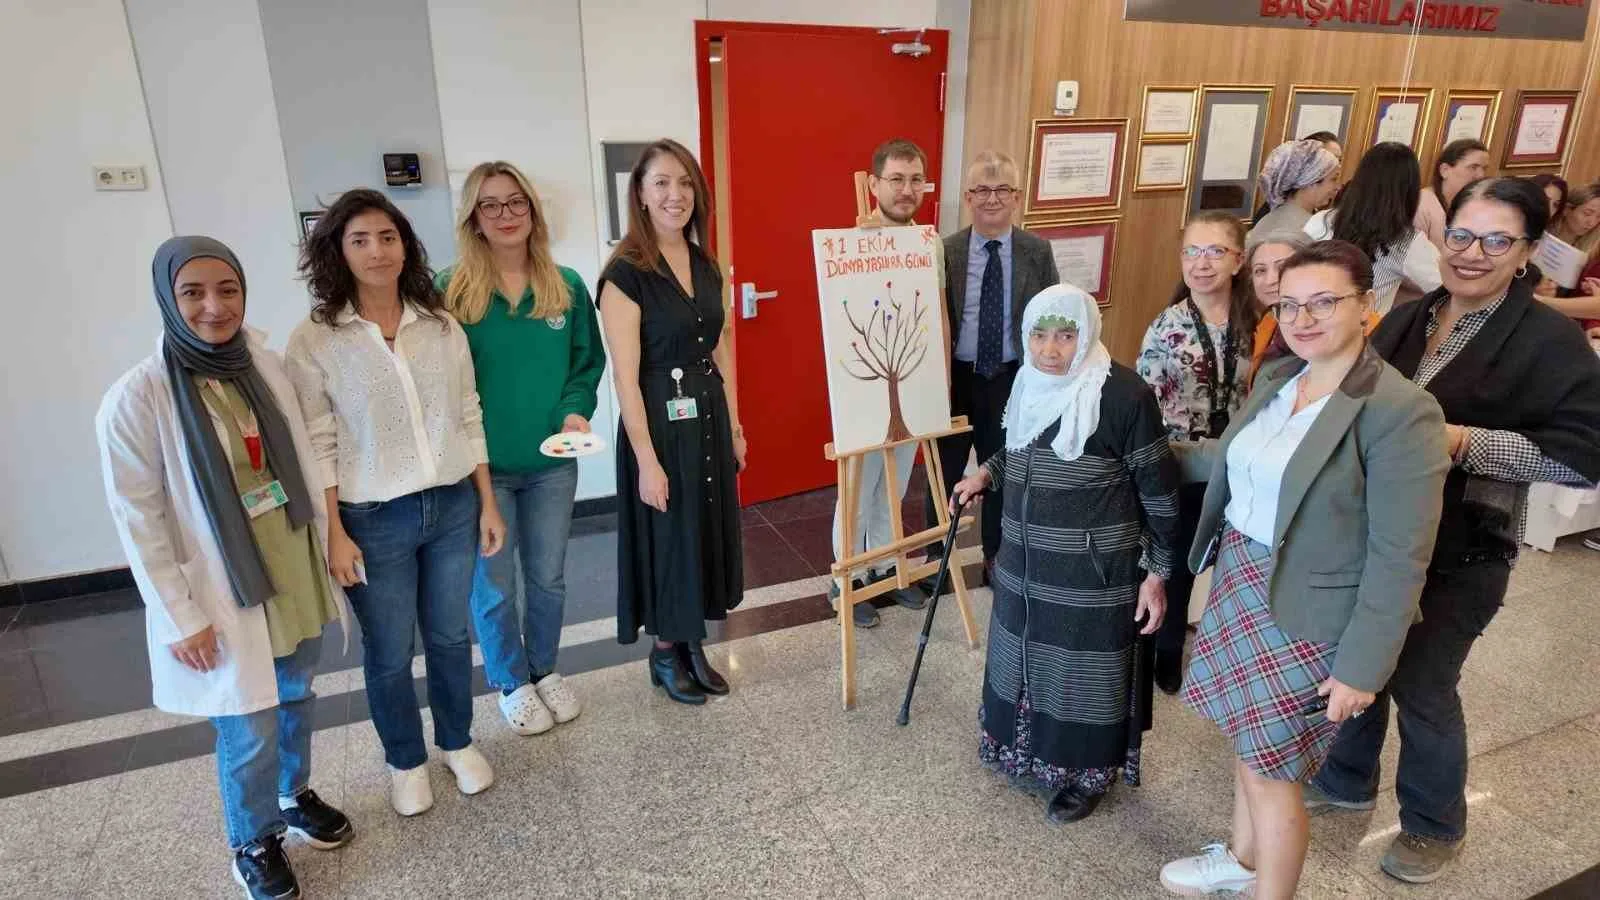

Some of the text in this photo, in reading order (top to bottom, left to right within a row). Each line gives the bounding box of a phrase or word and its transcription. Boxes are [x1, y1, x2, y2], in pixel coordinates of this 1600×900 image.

[1260, 0, 1500, 32] BAŞARILARIMIZ
[838, 232, 897, 254] 1 EKİM
[905, 251, 933, 269] GÜNÜ
